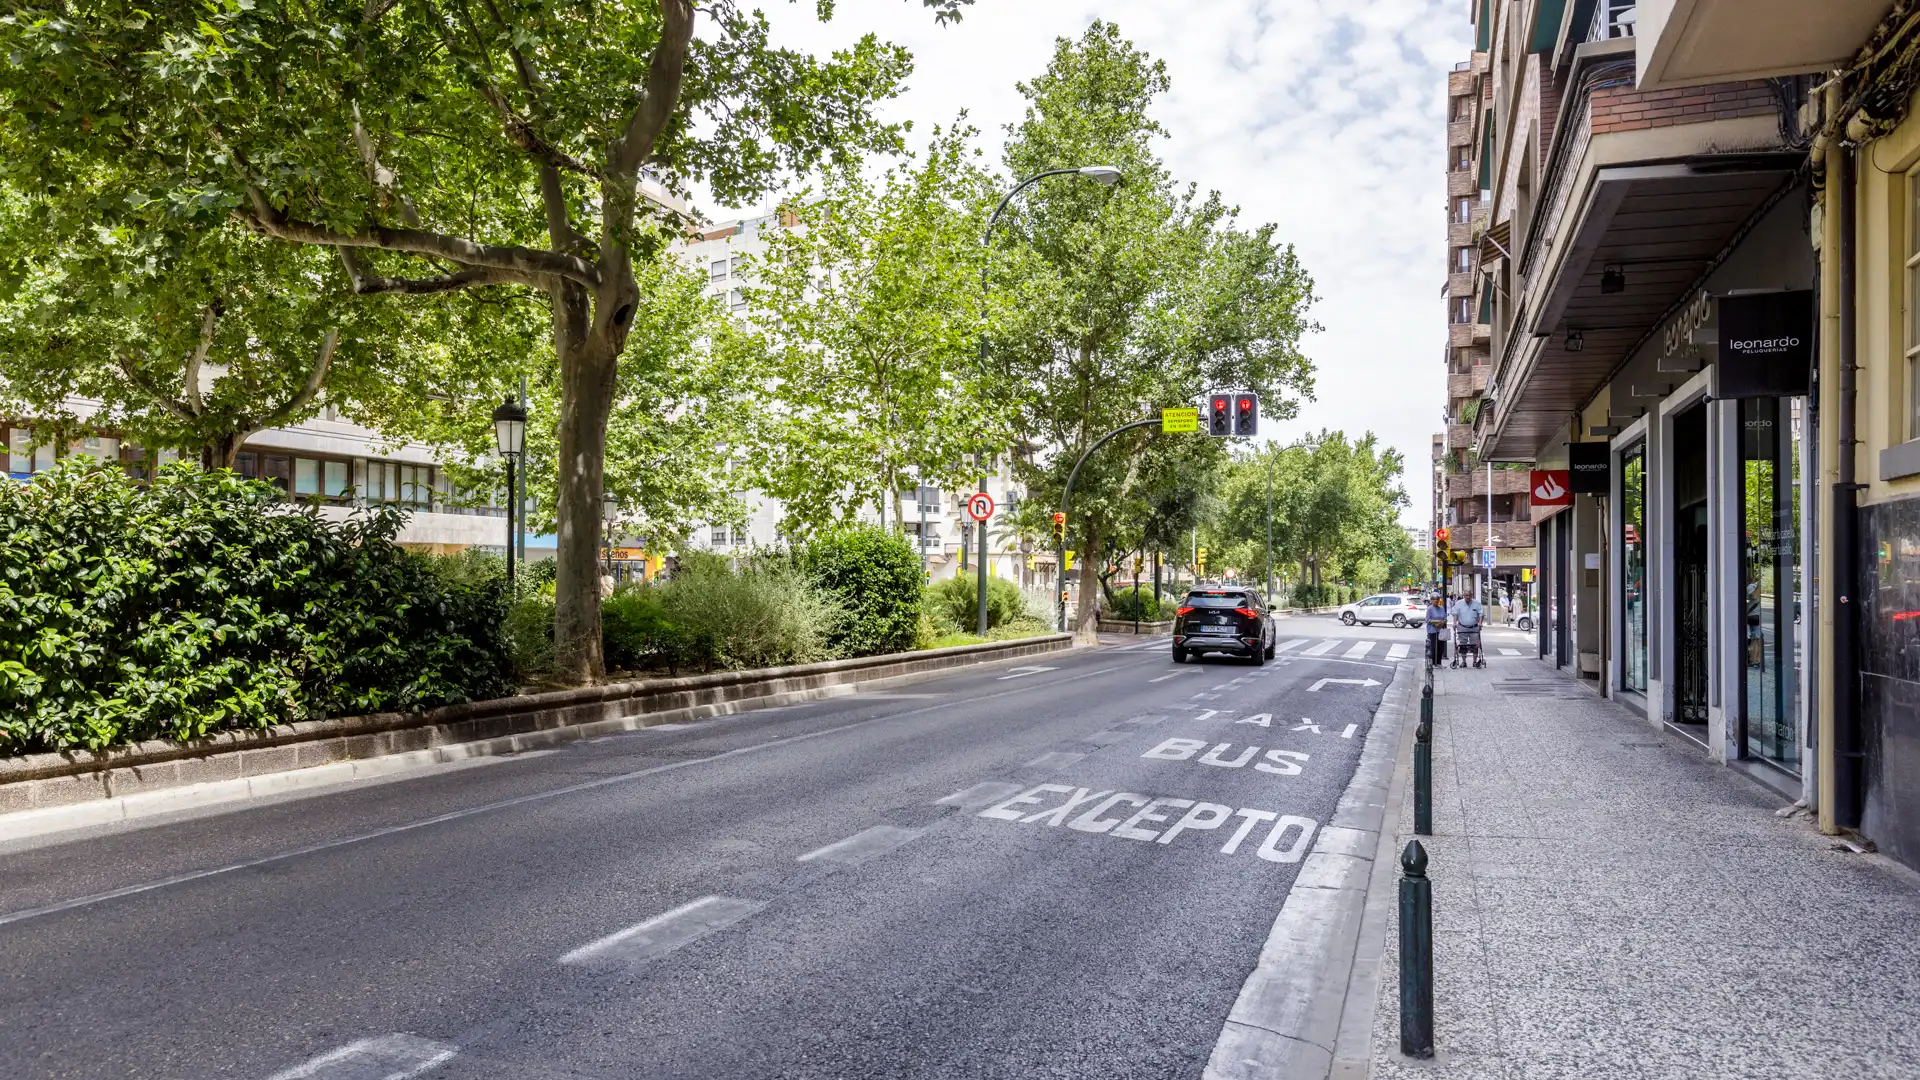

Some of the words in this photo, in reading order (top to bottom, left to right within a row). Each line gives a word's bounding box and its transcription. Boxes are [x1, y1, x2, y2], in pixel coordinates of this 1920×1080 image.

[1664, 287, 1711, 359] leonardo
[1730, 336, 1800, 350] leonardo
[1195, 708, 1359, 739] TAXI
[1140, 737, 1310, 776] BUS
[977, 783, 1319, 864] EXCEPTO
